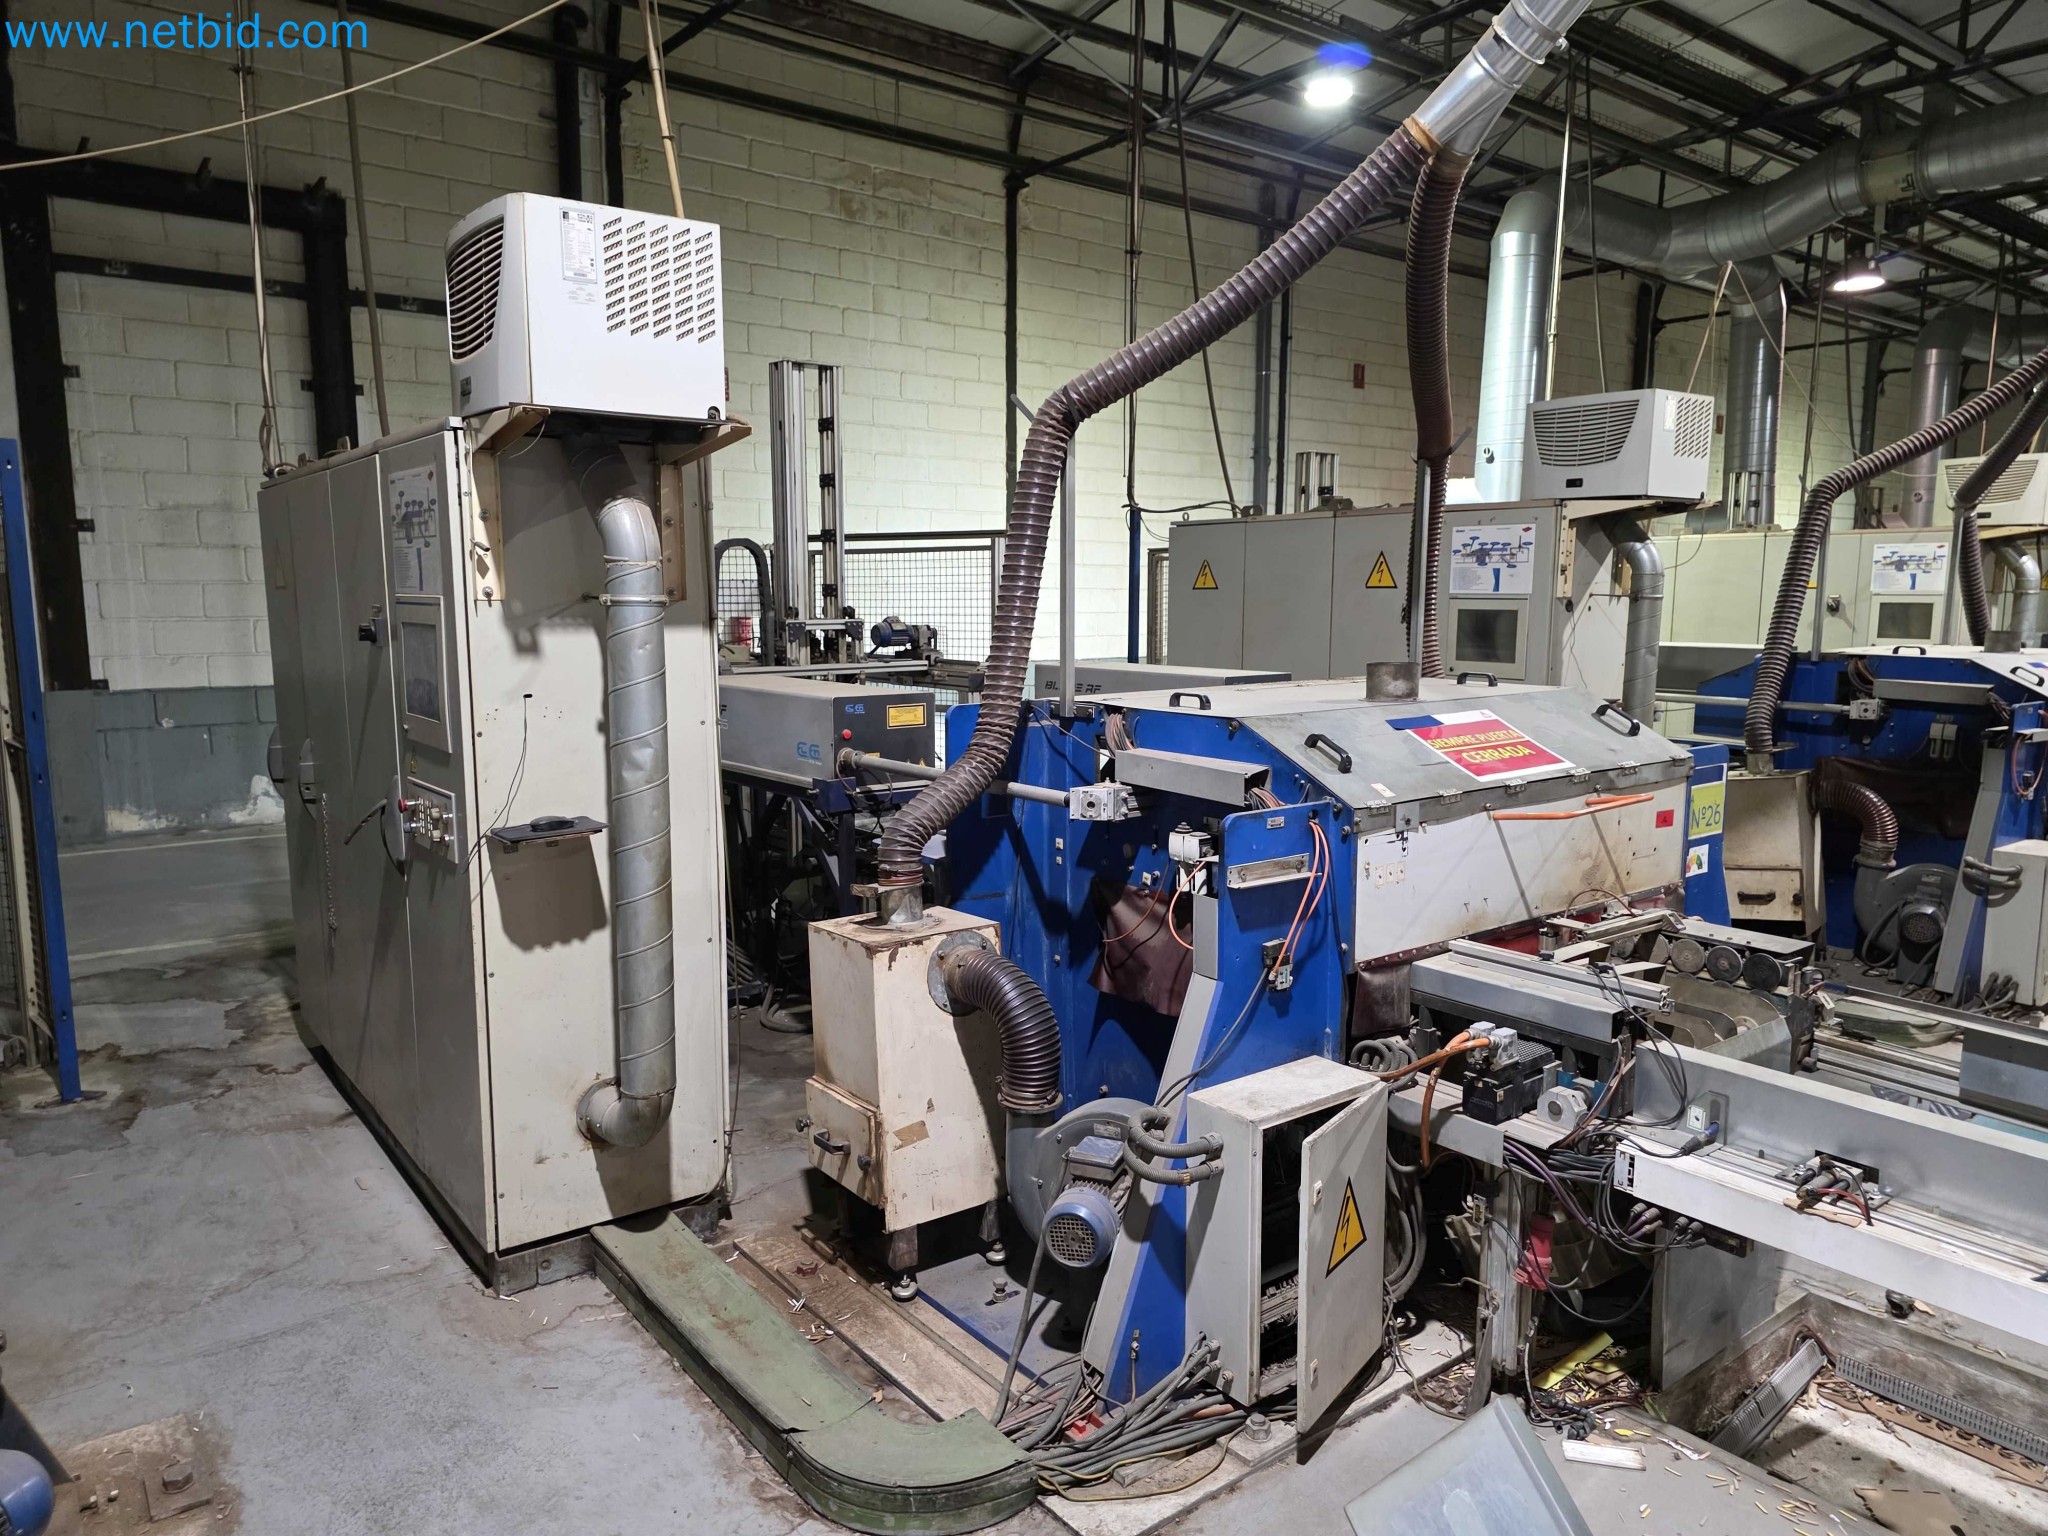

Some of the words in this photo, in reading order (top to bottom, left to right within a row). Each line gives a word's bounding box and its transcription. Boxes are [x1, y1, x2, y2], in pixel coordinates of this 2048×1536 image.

[1045, 681, 1083, 693] BLE
[1085, 684, 1102, 694] RF
[1427, 734, 1480, 749] SIEMPRE
[1475, 729, 1521, 742] PUERTA
[1461, 745, 1536, 763] CERRADA
